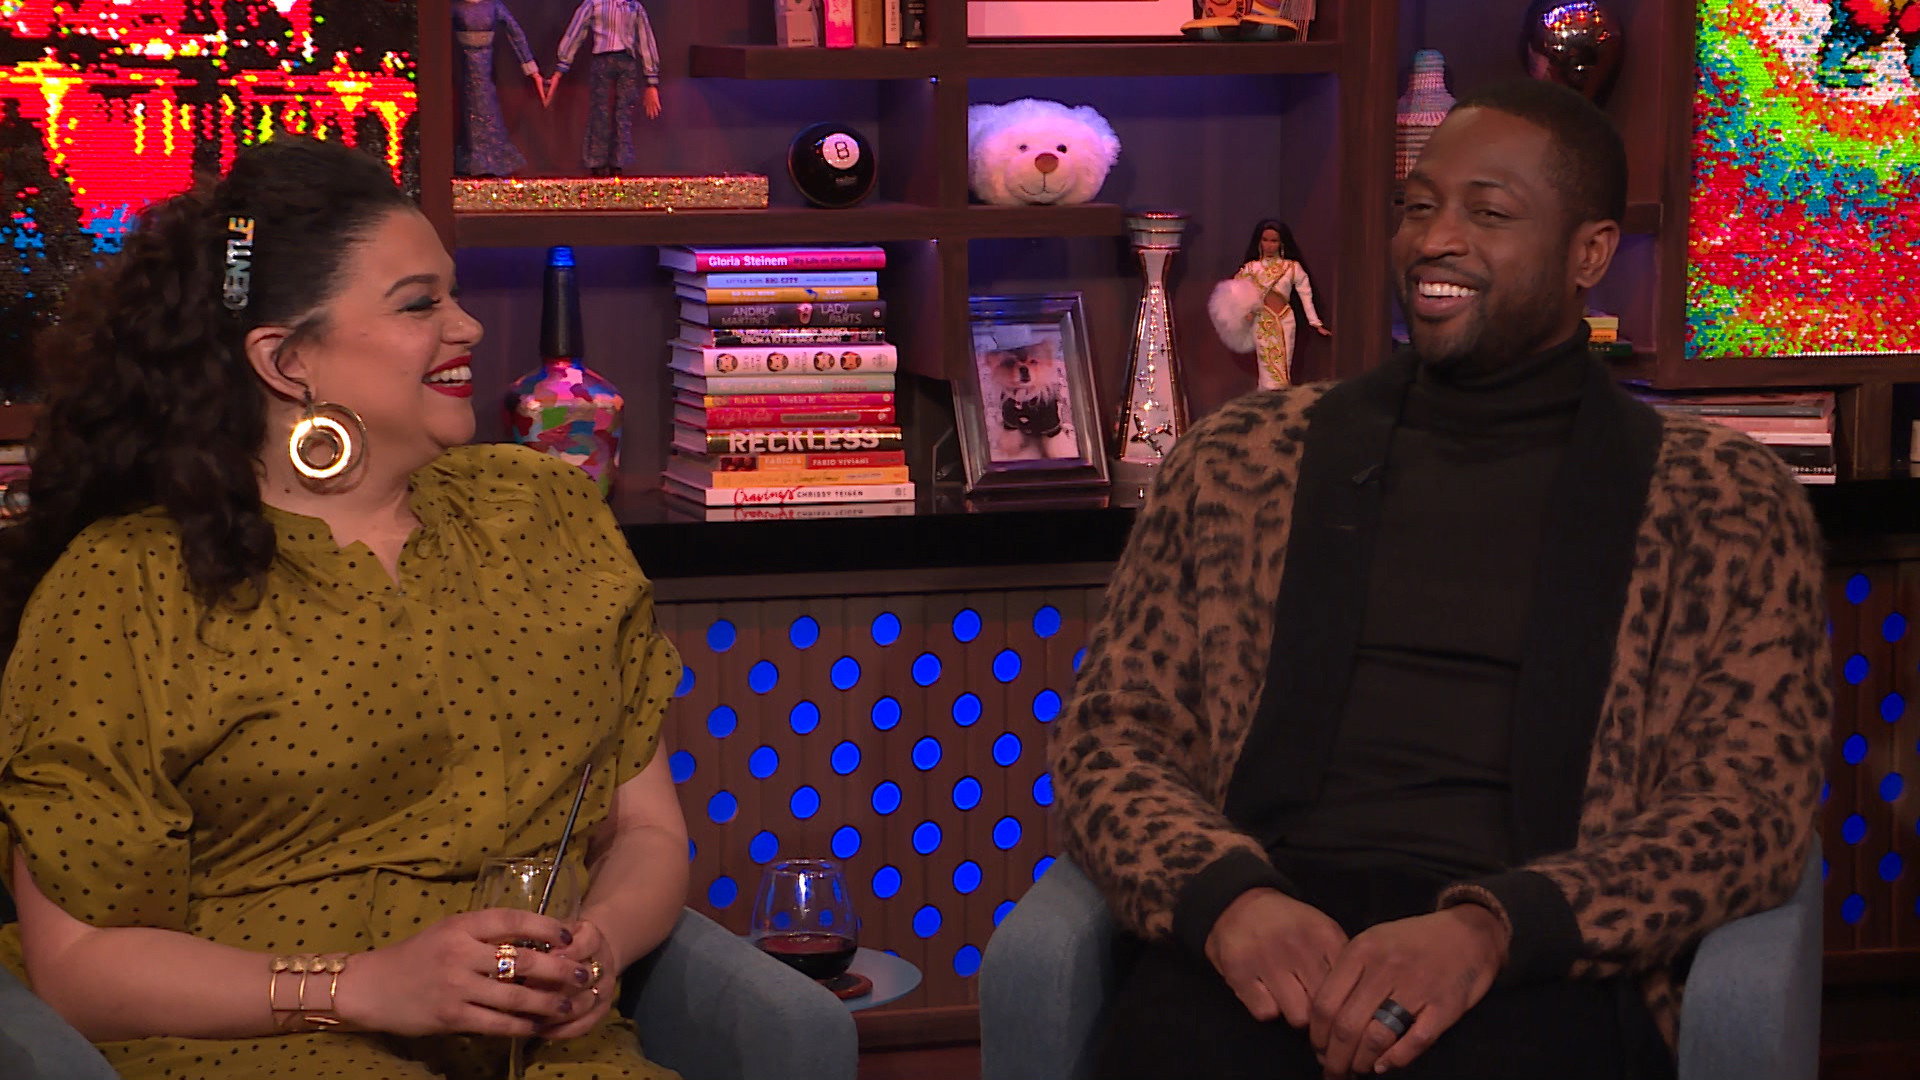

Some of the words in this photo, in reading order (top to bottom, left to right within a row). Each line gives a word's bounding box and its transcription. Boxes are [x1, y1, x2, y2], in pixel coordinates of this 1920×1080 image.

[834, 141, 850, 159] 8
[223, 217, 255, 310] GENTLE
[708, 255, 740, 267] Gloria
[743, 255, 788, 266] Steinem
[732, 305, 776, 316] ANDREA
[820, 303, 850, 314] LADY
[828, 313, 862, 324] PARTS
[728, 428, 880, 454] RECKLESS
[734, 486, 804, 504] Cravings
[797, 491, 831, 499] CHRISSY
[834, 490, 864, 498] TEIGEN
